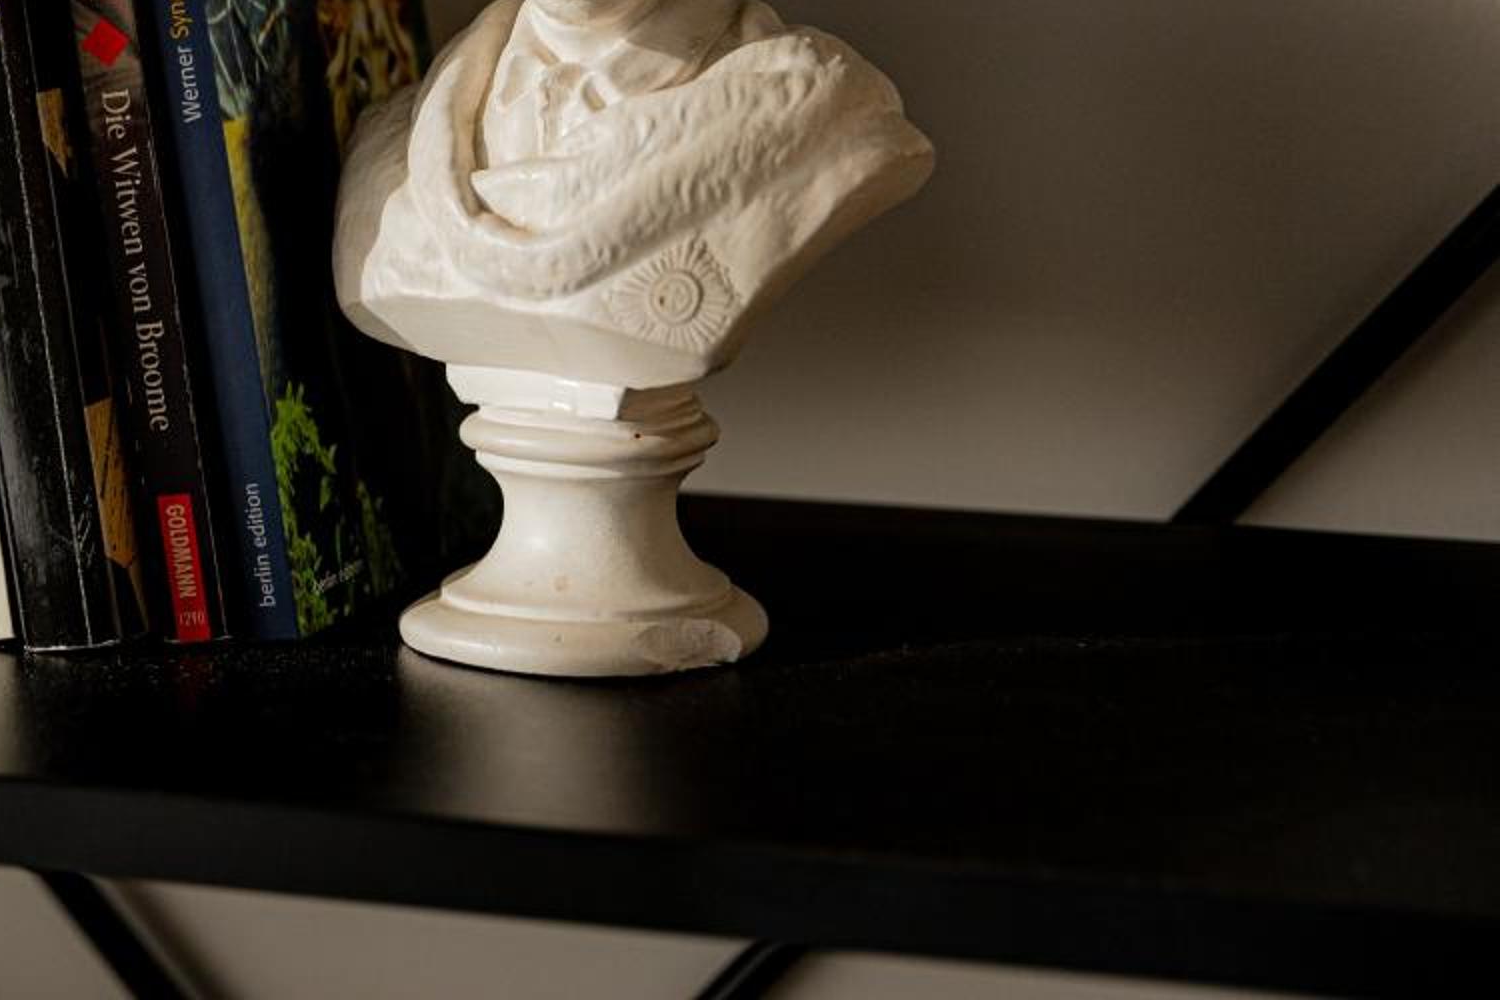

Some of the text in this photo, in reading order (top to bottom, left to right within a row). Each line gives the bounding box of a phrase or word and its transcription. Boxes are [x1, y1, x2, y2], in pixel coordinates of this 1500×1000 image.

[173, 45, 202, 122] Werner
[103, 89, 167, 431] Die Witwen von Broome
[167, 504, 196, 598] GOLDMANN
[243, 483, 276, 607] berlin edition
